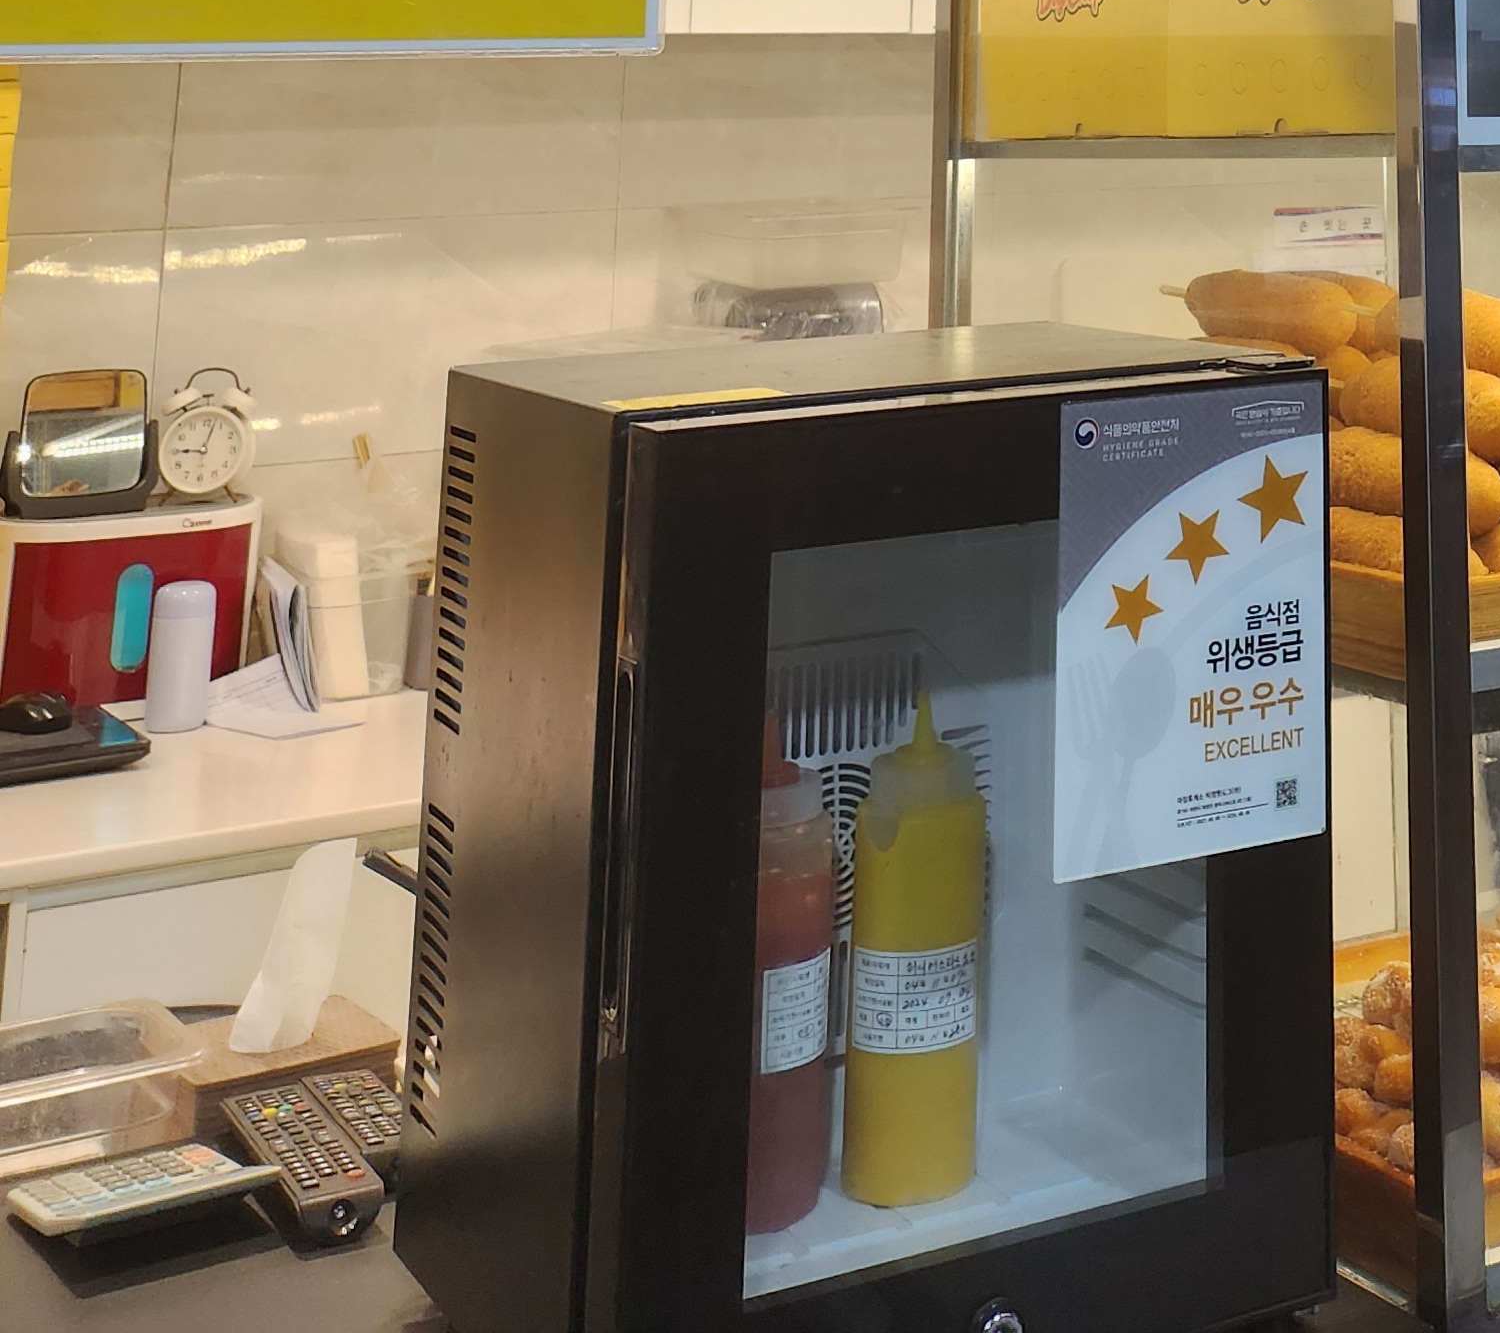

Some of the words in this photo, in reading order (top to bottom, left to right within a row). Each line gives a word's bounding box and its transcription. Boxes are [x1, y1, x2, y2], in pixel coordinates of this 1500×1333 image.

[1103, 441, 1144, 452] HYGIENE
[1149, 437, 1179, 447] GRADE
[1103, 449, 1164, 461] CERTIFICATE
[1245, 599, 1300, 630] 음식점
[1207, 629, 1304, 673] 위생등급
[1190, 687, 1244, 728] 매우
[1250, 677, 1304, 720] 우수
[1205, 727, 1304, 763] EXCELLENT
